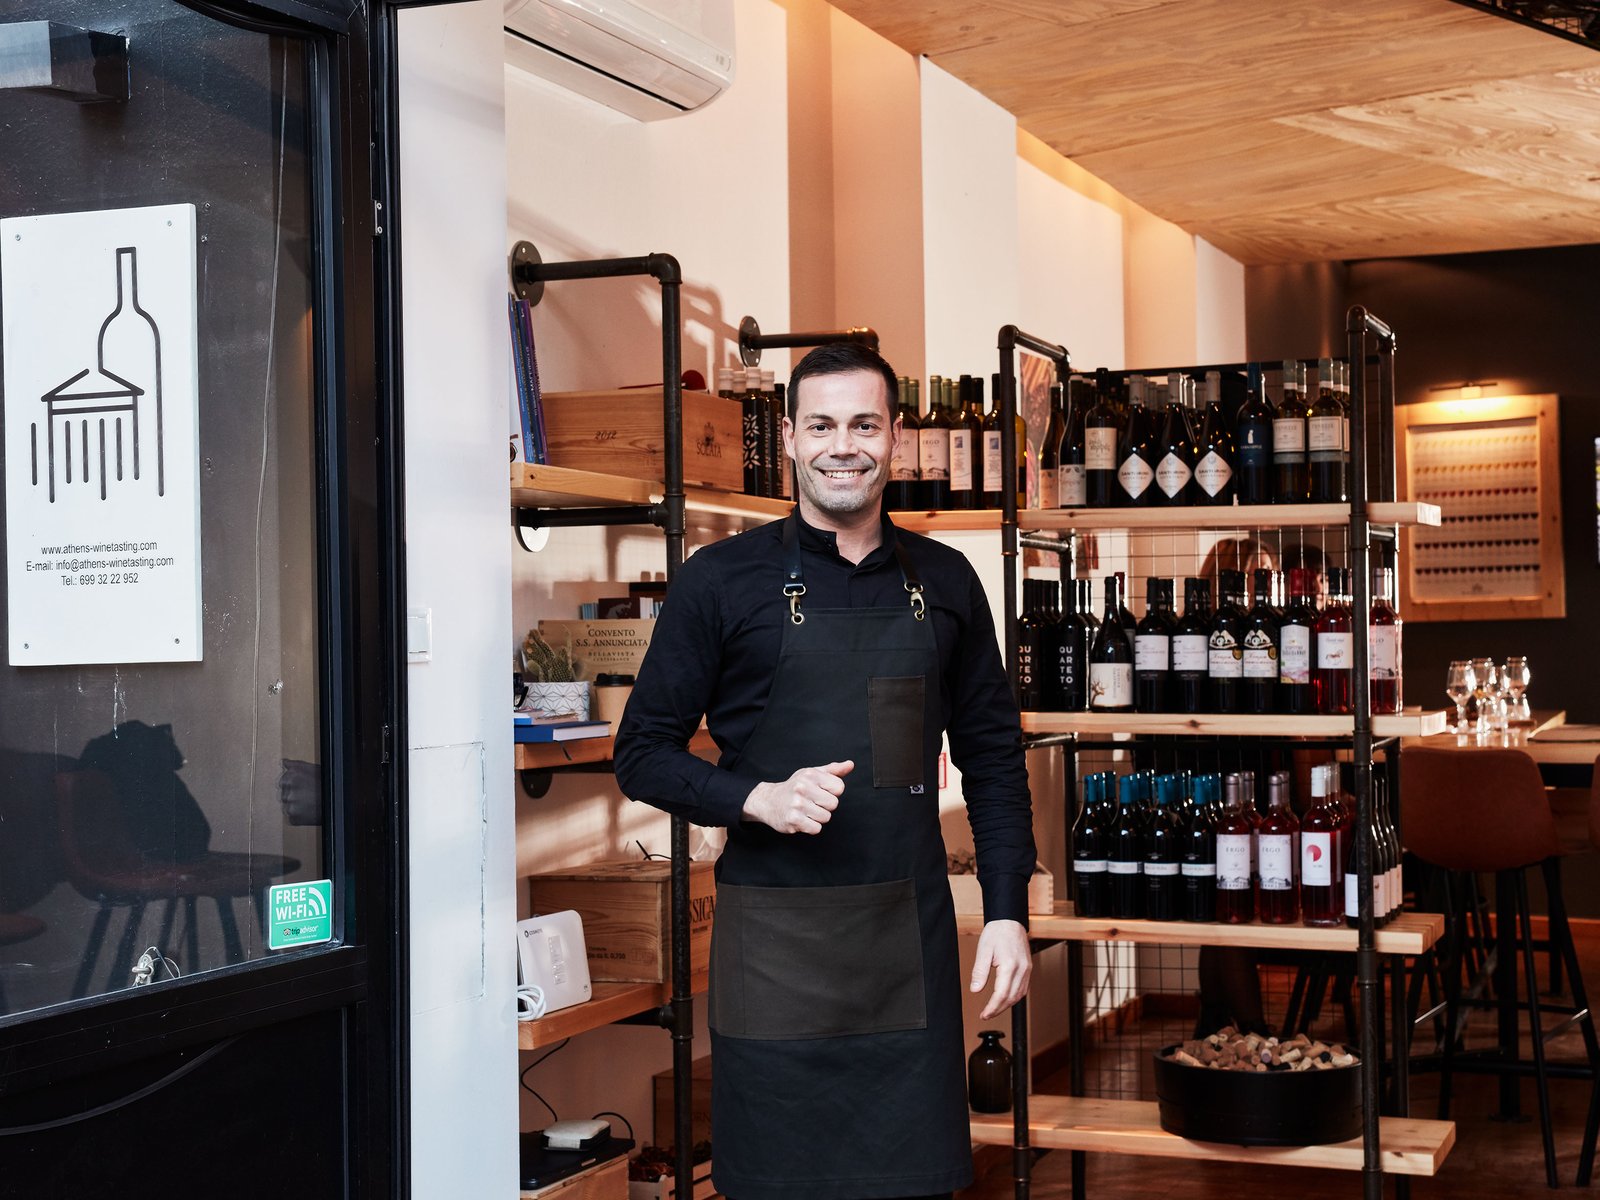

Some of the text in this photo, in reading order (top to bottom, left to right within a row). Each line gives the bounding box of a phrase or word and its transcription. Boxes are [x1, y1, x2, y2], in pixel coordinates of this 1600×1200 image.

[594, 430, 617, 440] 2012
[41, 541, 158, 555] www.athens-winetasting.com
[26, 556, 174, 572] E-mail: info@athens-winetasting.com
[61, 573, 139, 586] Tel.: 699 32 22 952
[588, 629, 636, 637] CONVENTO
[575, 639, 648, 647] S.S. ANNUNCIATA
[276, 887, 307, 905] FREE
[275, 904, 307, 921] WI-FI
